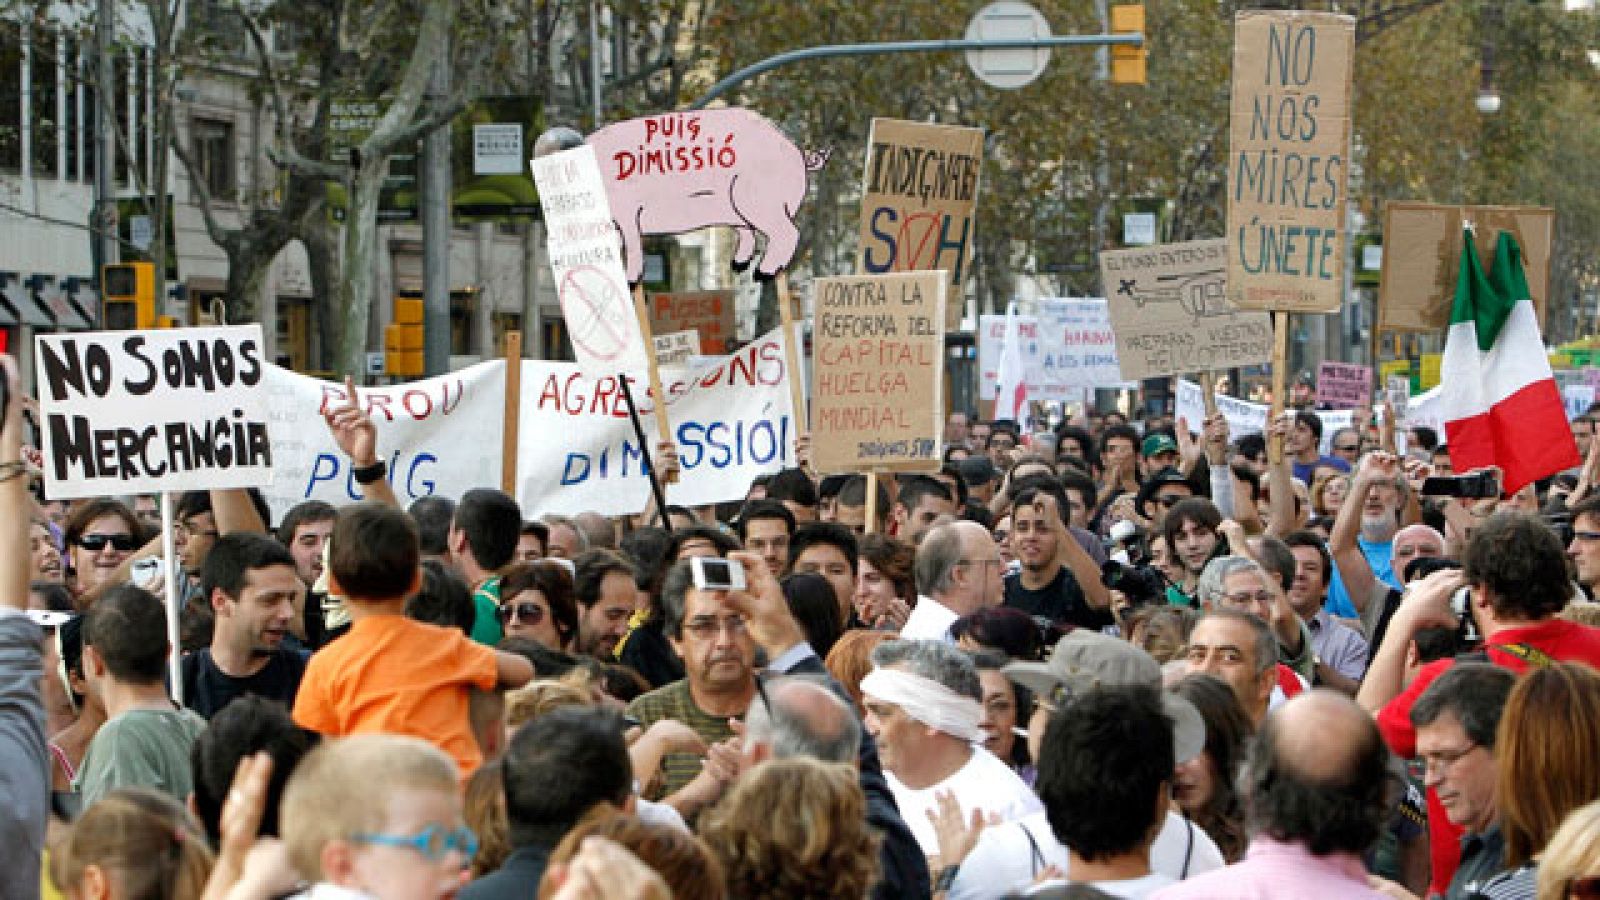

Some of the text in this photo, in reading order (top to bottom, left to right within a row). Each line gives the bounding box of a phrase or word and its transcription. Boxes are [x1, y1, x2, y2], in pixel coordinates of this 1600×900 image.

[1263, 24, 1316, 86] NO
[1249, 94, 1319, 142] NOS
[1238, 215, 1336, 281] ÚNETE
[823, 282, 923, 307] CONTRA LA
[820, 312, 898, 338] REFORMA
[40, 338, 113, 401] NO
[819, 339, 932, 366] CAPITAL
[819, 372, 909, 396] HUELGA
[819, 406, 911, 432] MUNDIAL
[560, 402, 790, 486] DIMSSIÓ!
